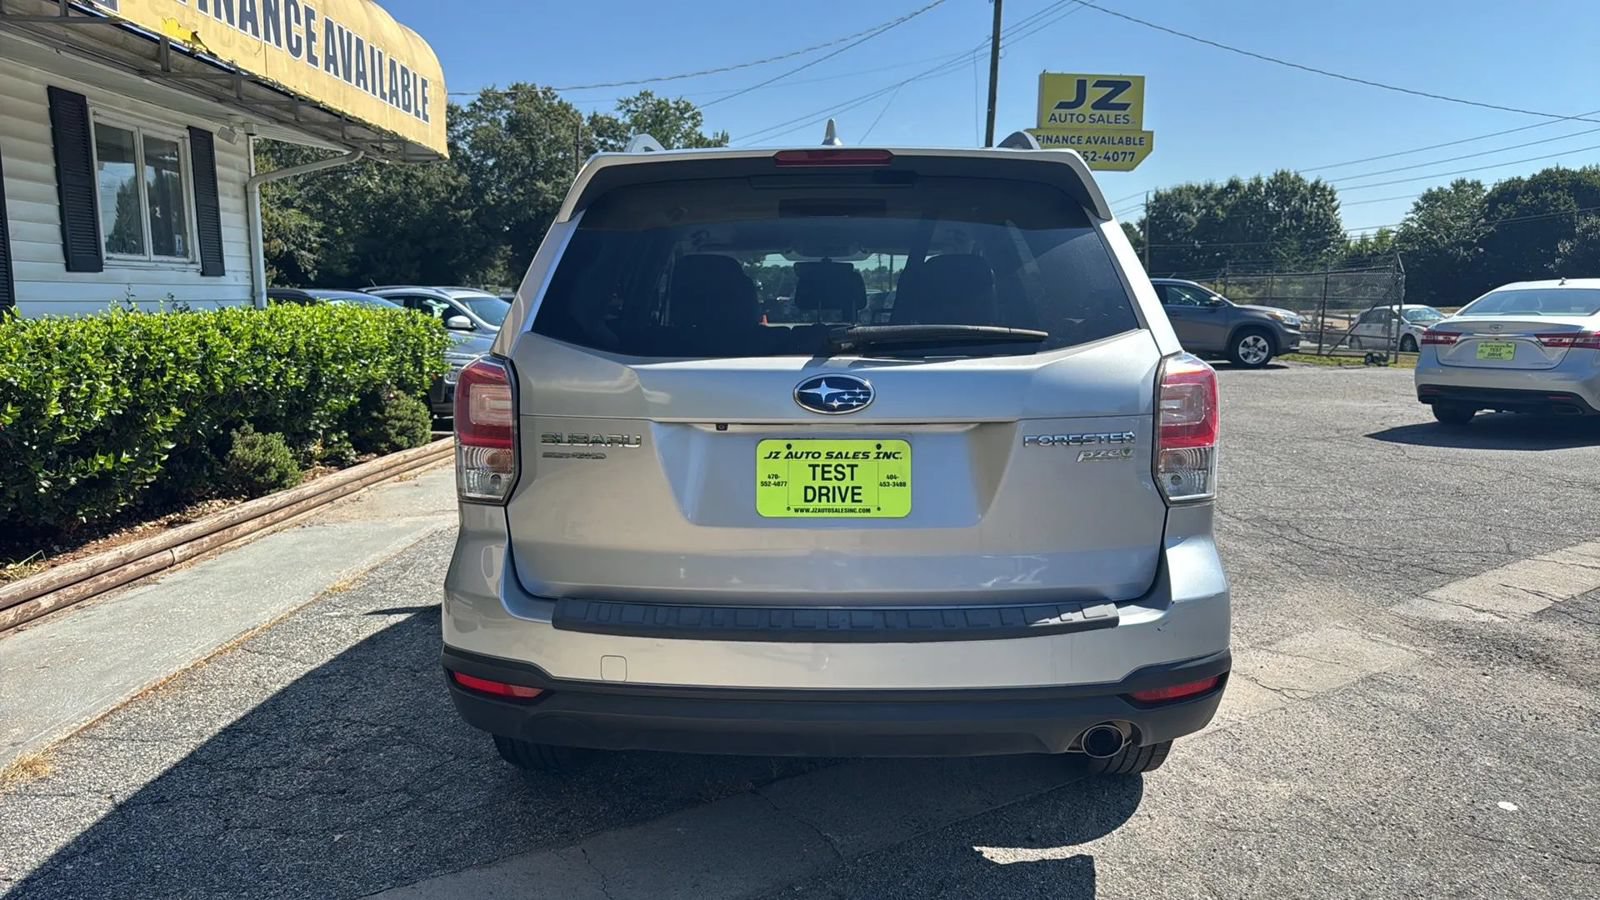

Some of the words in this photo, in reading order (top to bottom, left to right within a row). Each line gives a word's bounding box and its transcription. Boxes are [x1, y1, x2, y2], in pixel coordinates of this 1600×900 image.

[324, 17, 430, 124] AVAILABLE
[1054, 79, 1132, 111] JZ
[1048, 113, 1086, 124] AUTO
[1089, 113, 1130, 125] SALES
[1036, 135, 1083, 145] FINANCE
[1085, 136, 1145, 146] AVAILABLE
[541, 432, 641, 448] SUBARU
[1023, 431, 1136, 447] FORESTER
[764, 451, 781, 460] JZ
[784, 451, 822, 460] AUTO
[825, 451, 871, 460] SALES
[808, 463, 858, 481] TEST
[803, 486, 863, 503] DRIVE
